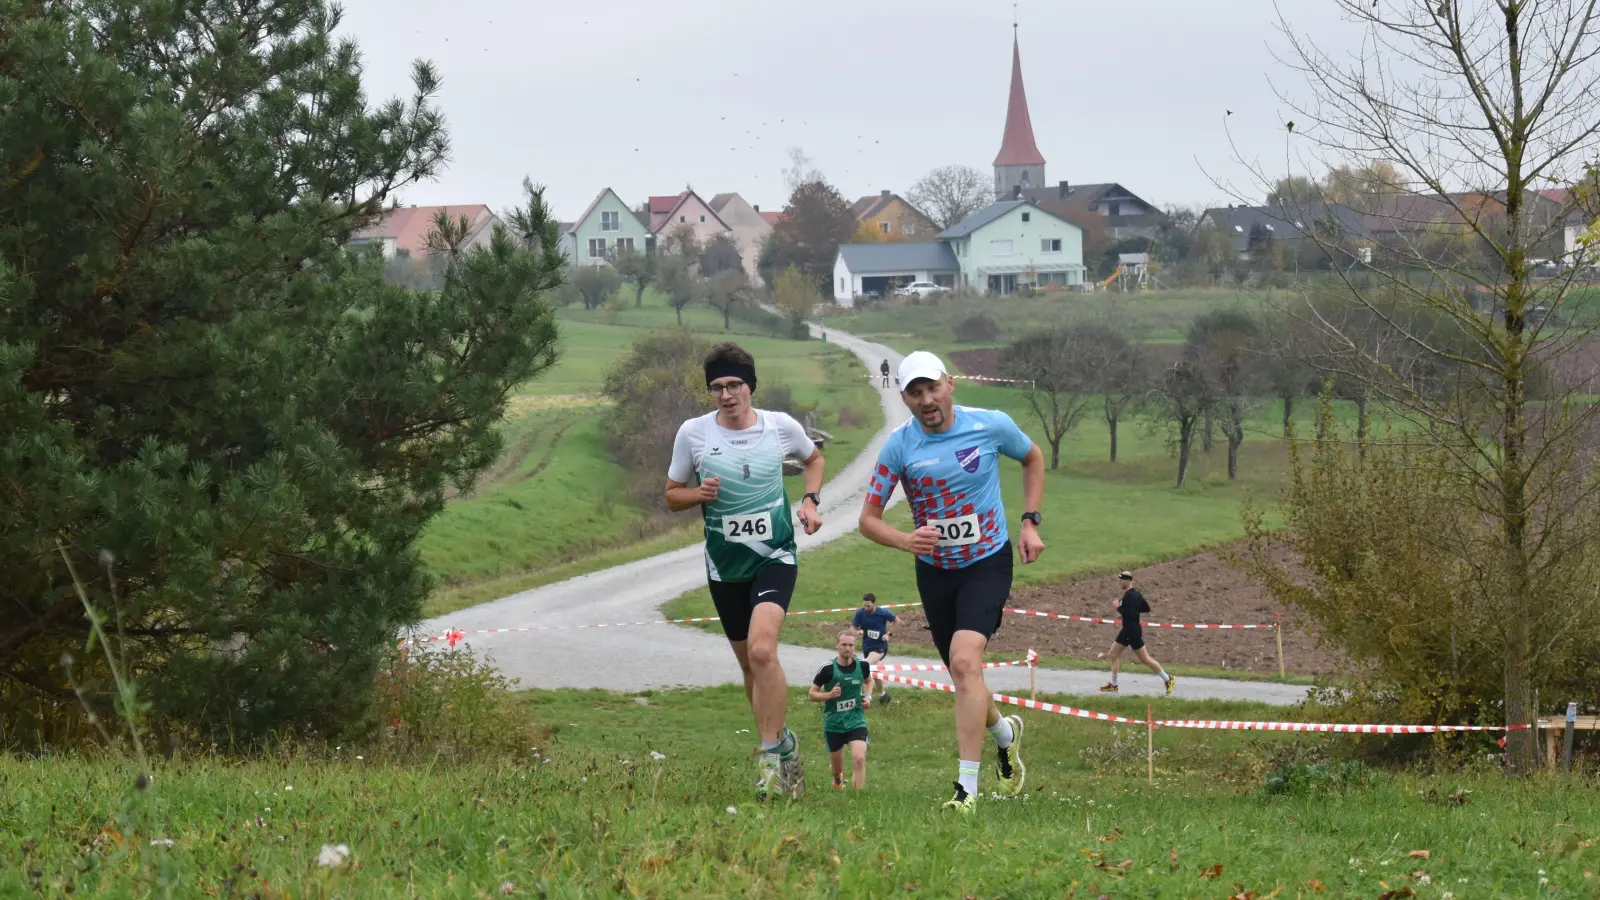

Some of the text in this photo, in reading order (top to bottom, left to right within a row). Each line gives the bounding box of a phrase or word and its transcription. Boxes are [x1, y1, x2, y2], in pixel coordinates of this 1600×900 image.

[728, 518, 767, 537] 246
[935, 521, 975, 541] 202
[839, 701, 854, 709] 142
